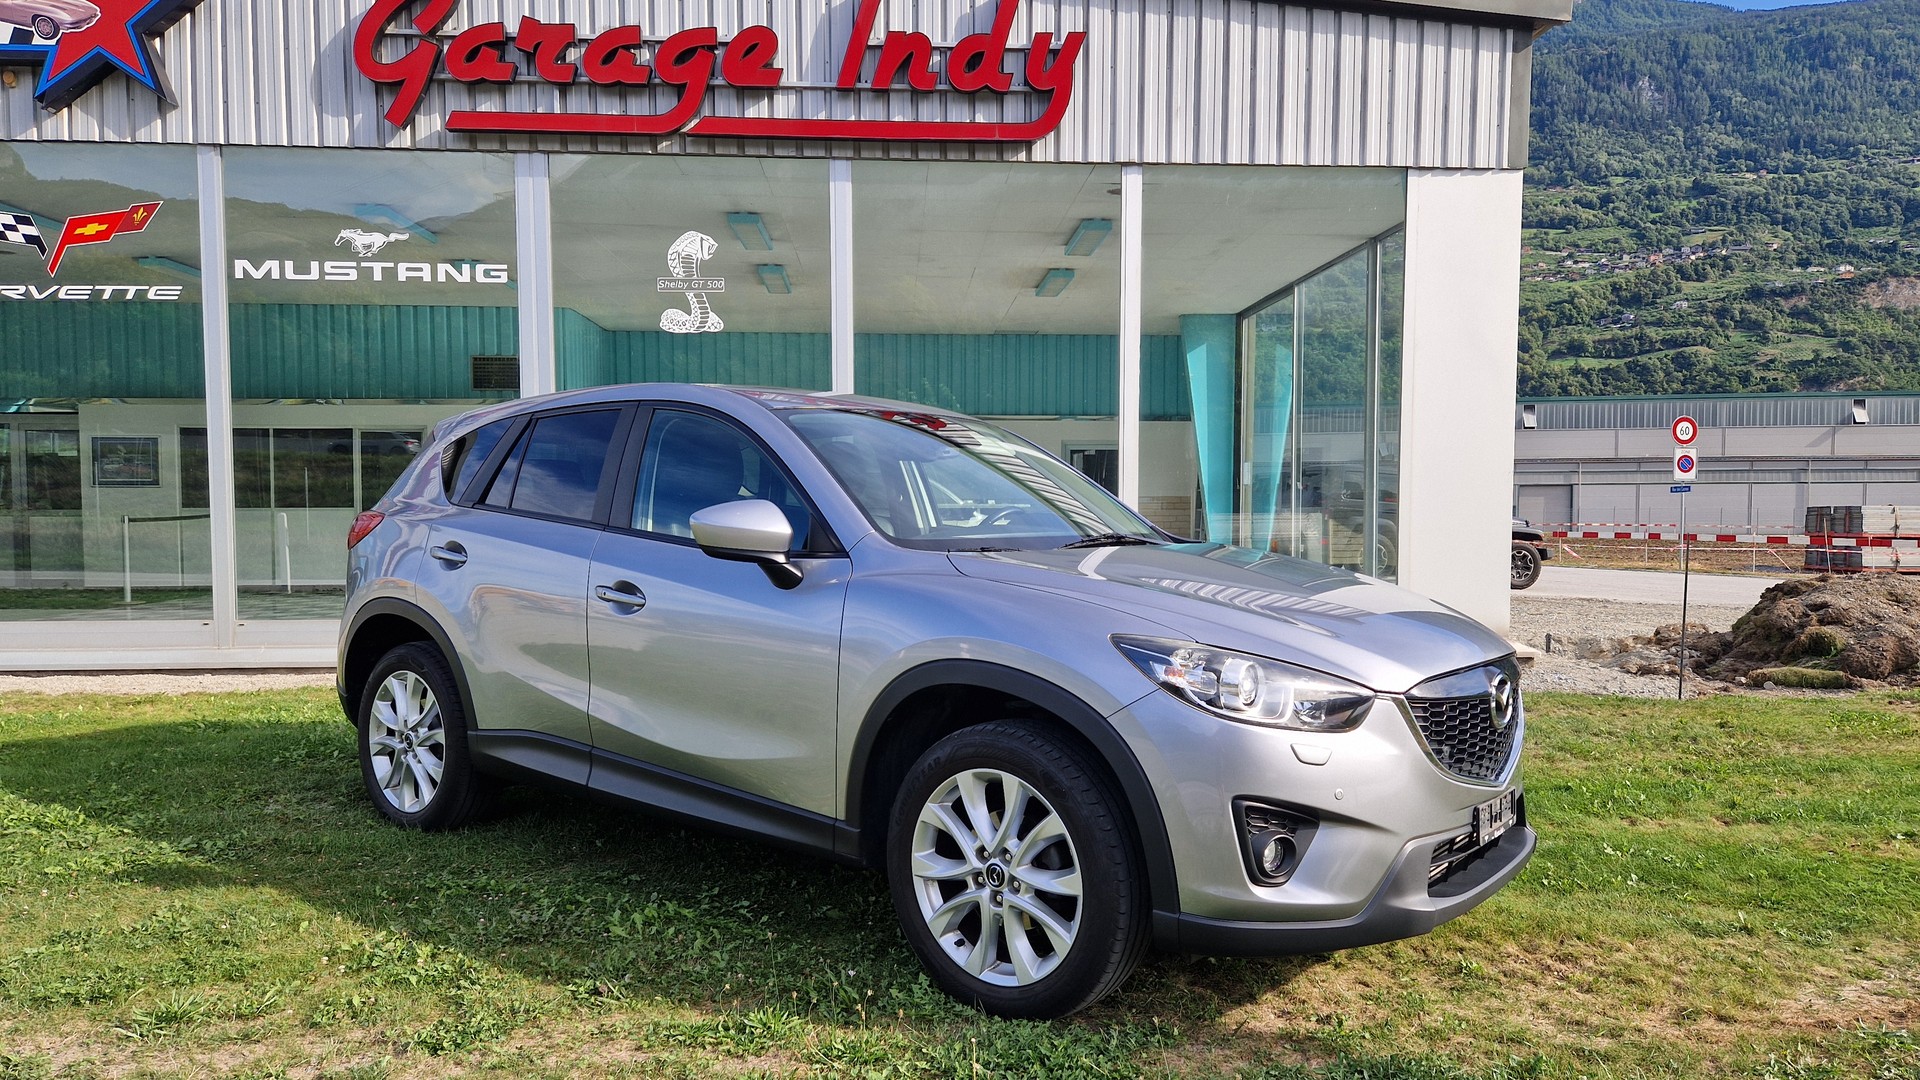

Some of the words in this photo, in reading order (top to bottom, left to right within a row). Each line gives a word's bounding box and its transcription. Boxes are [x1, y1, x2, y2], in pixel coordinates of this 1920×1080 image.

[353, 0, 783, 135] Garage
[836, 0, 1087, 142] Indy
[234, 258, 509, 284] MUSTANG
[658, 280, 689, 289] Shelby
[691, 280, 705, 288] GT
[707, 280, 724, 289] 500
[1679, 426, 1690, 436] 60
